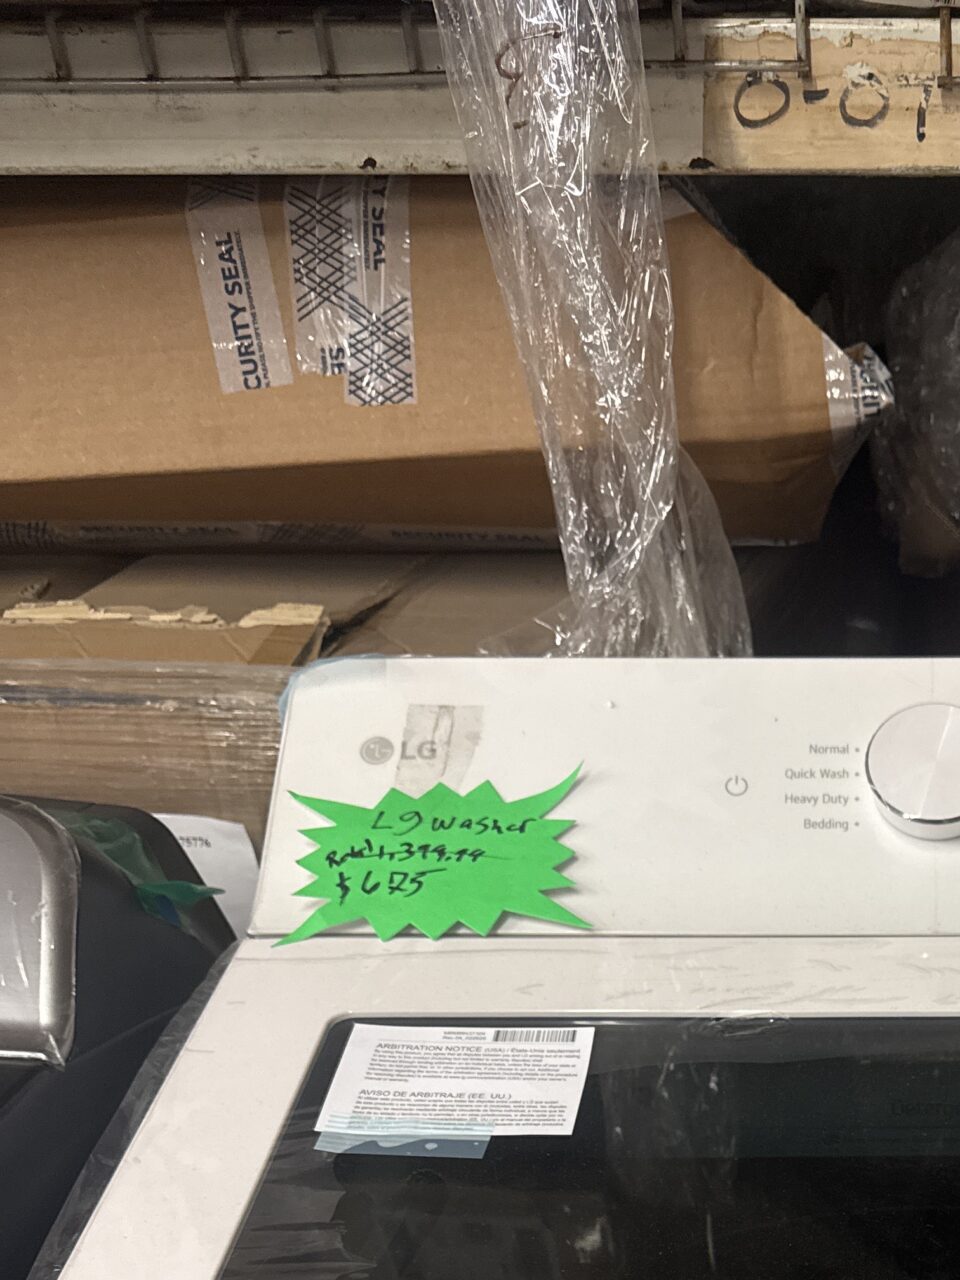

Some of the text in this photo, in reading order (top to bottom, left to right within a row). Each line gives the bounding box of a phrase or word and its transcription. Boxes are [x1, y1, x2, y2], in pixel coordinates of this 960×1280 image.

[371, 206, 386, 271] SEAL
[215, 231, 243, 296] SEAL
[400, 740, 437, 761] LG
[808, 744, 850, 755] Normal
[785, 768, 850, 780] Quick Wash
[784, 793, 849, 806] Heavy Duty
[803, 818, 849, 832] Bedding
[376, 1043, 443, 1052] ARBITRATION
[359, 1089, 391, 1097] AVISO
[393, 1090, 407, 1098] DE
[408, 1091, 465, 1099] ARBITRAJE
